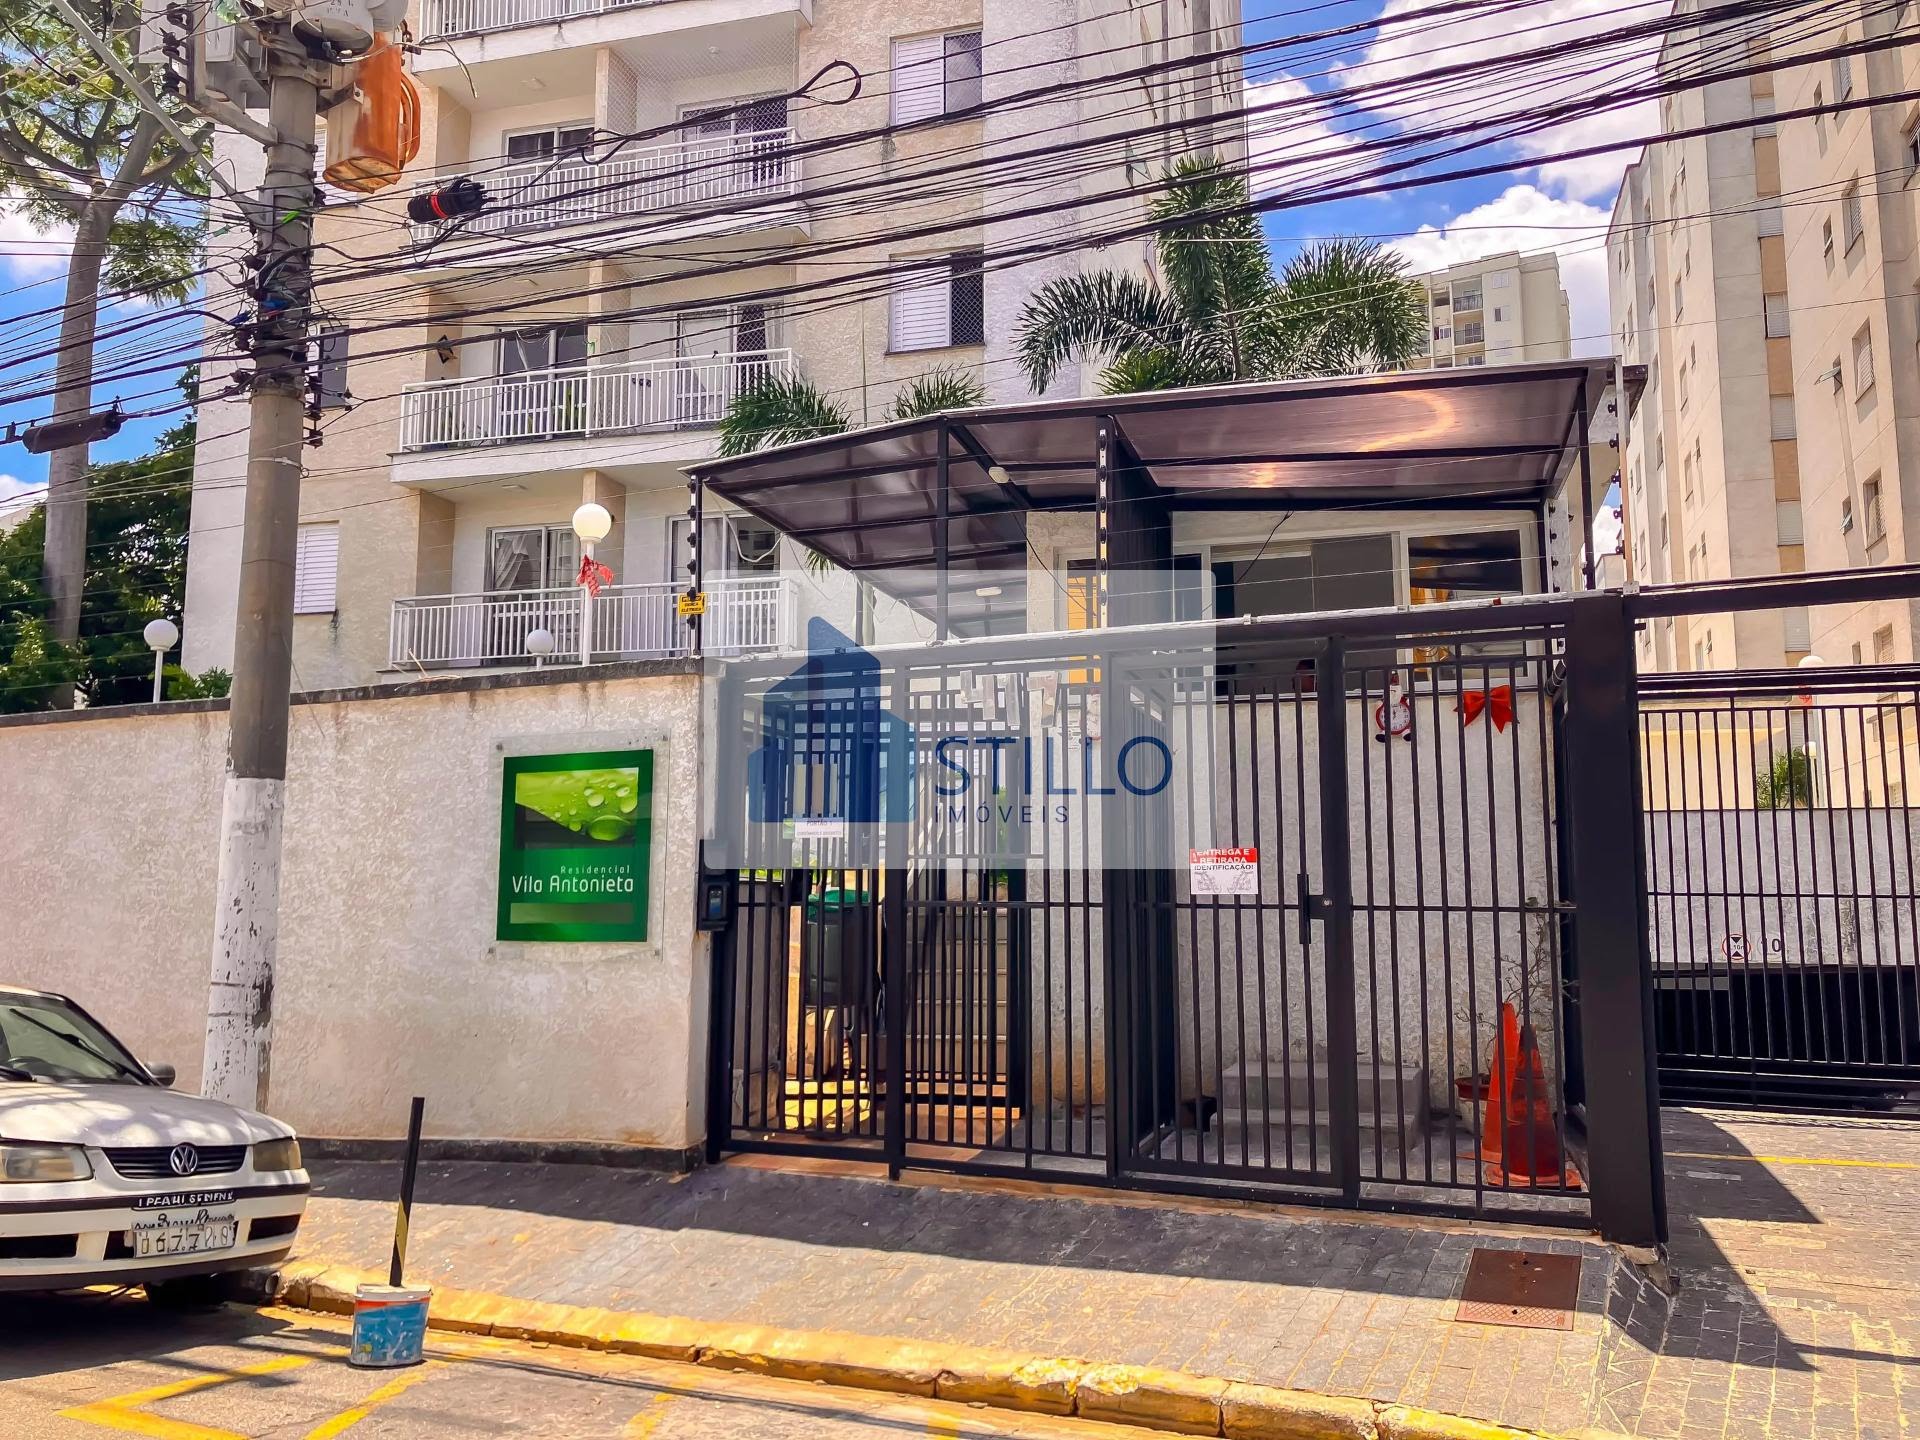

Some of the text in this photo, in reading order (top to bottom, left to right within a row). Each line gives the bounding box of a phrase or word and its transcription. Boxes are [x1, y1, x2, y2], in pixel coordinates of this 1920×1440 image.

[1196, 848, 1241, 856] ENTREGA
[1200, 856, 1247, 864] RETIRADA
[560, 865, 630, 875] Residencial
[512, 875, 634, 893] Vila Antonieta
